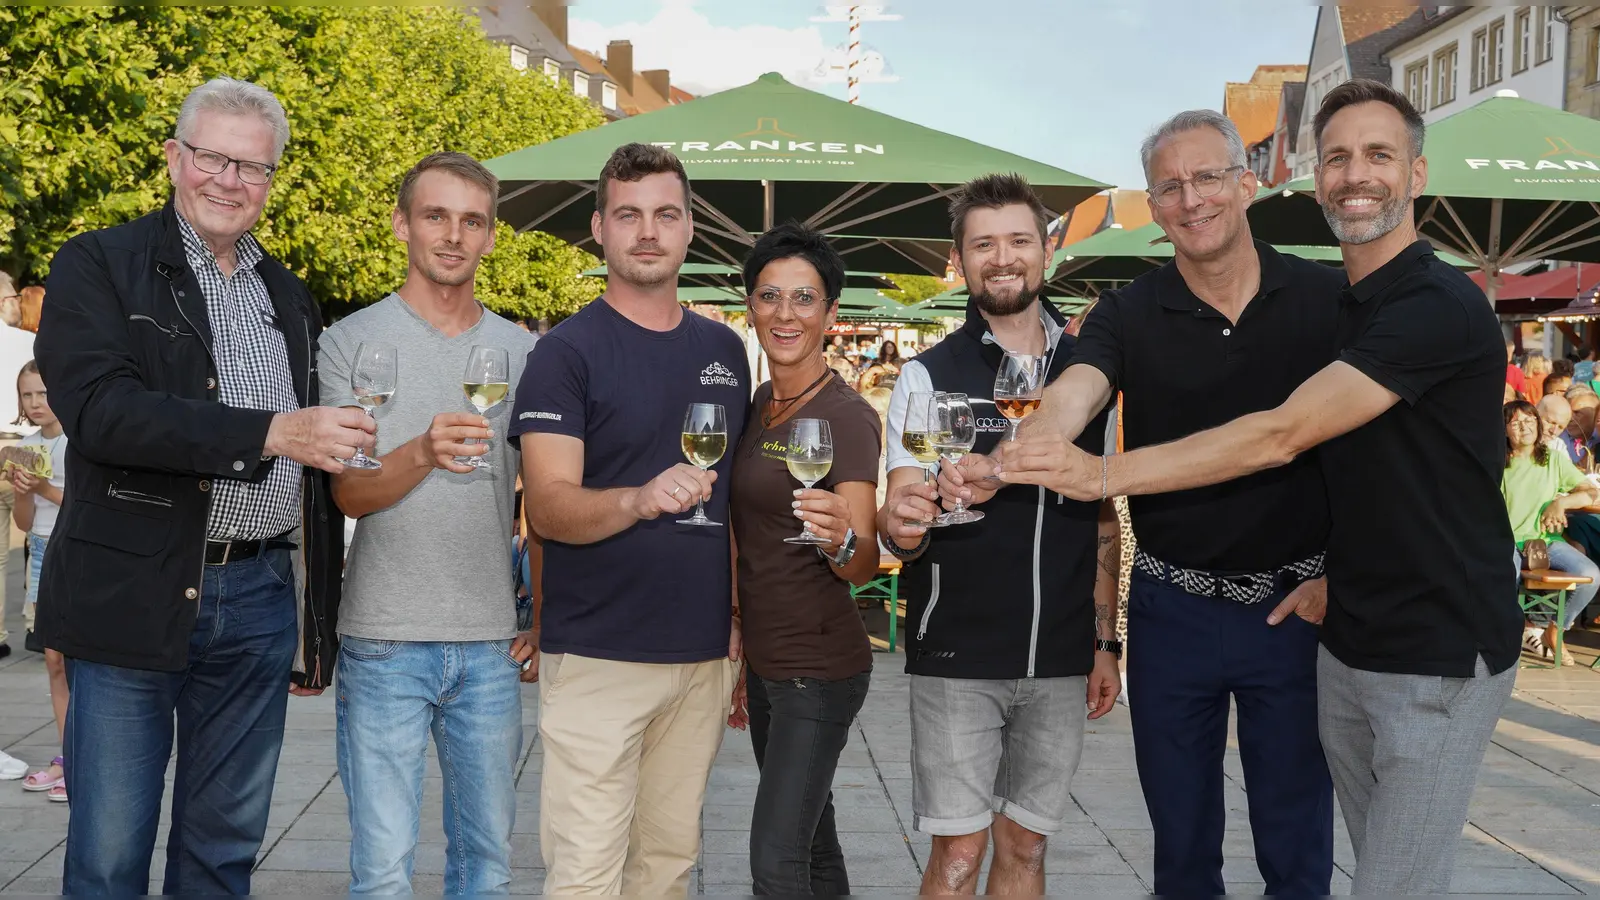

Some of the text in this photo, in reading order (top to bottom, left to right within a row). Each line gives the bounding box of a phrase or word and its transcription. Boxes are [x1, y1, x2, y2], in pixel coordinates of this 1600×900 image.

[650, 140, 884, 155] FRANKEN
[1465, 158, 1600, 171] FRAN
[700, 376, 739, 387] BEHRINGER
